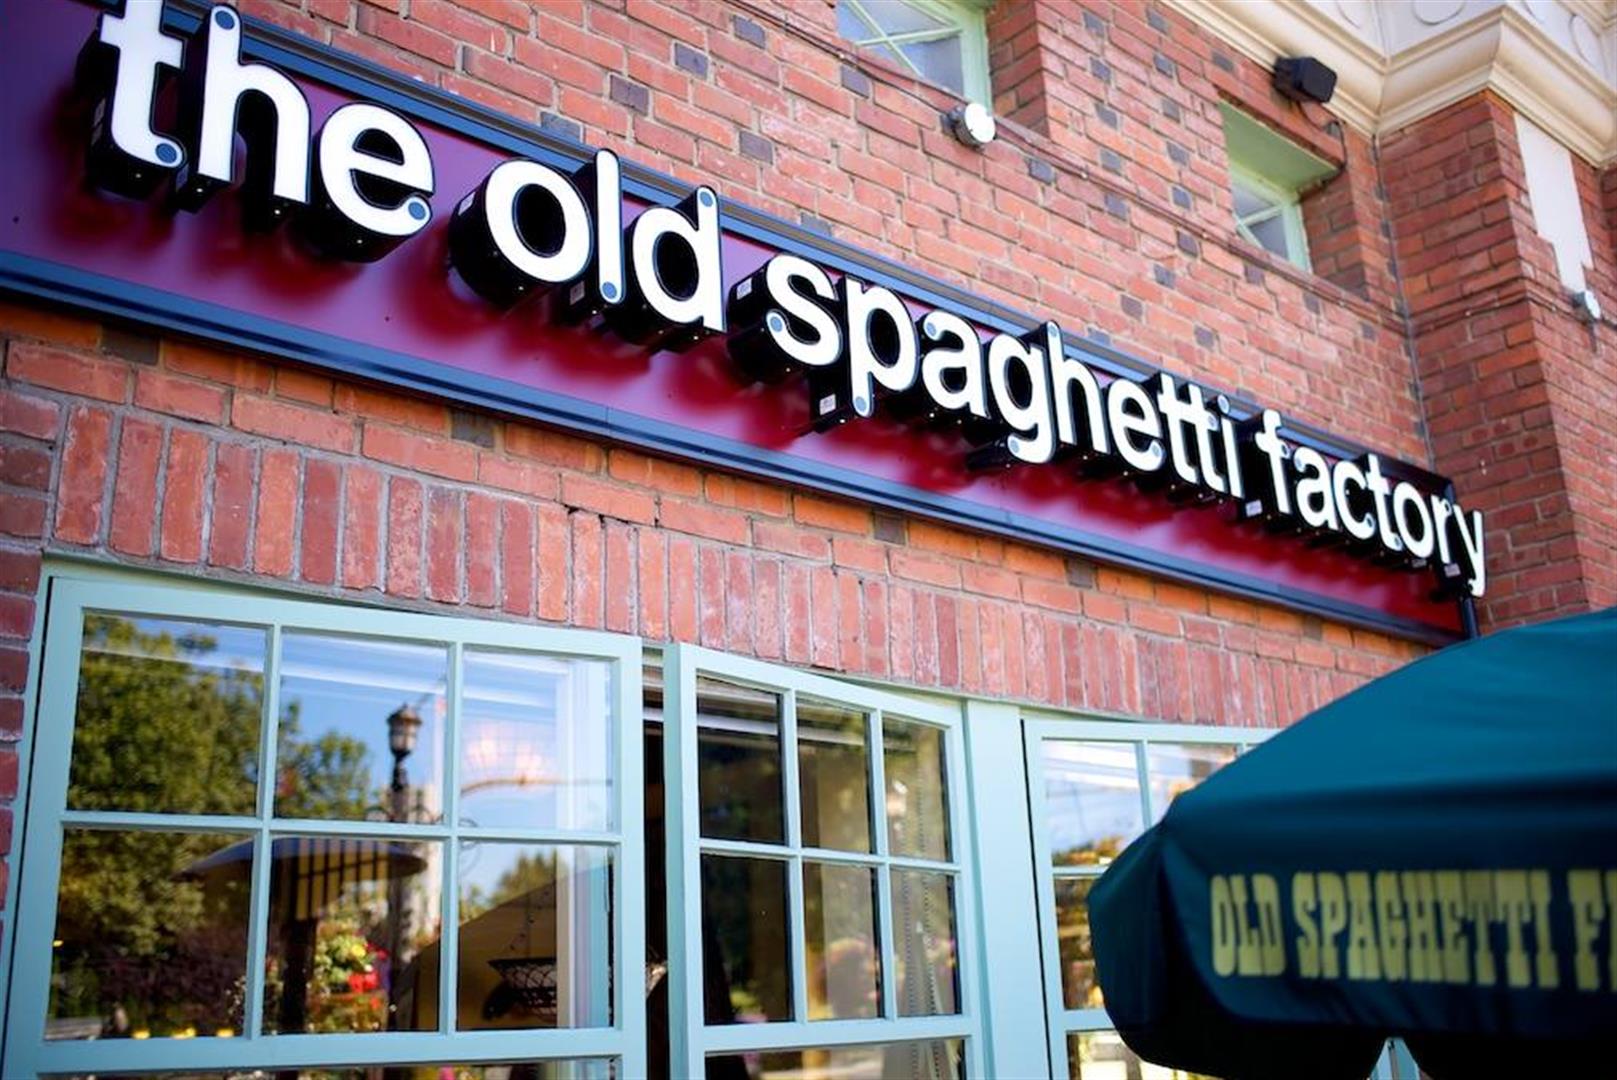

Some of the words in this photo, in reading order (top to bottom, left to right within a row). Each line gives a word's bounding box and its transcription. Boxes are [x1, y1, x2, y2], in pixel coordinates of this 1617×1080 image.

[99, 0, 434, 238] the
[484, 149, 726, 332] old
[765, 254, 1244, 498] spaghetti
[1256, 410, 1485, 597] factory
[1211, 874, 1286, 977] OLD
[1292, 869, 1559, 988] SPAGHETTI
[1567, 869, 1617, 992] F
